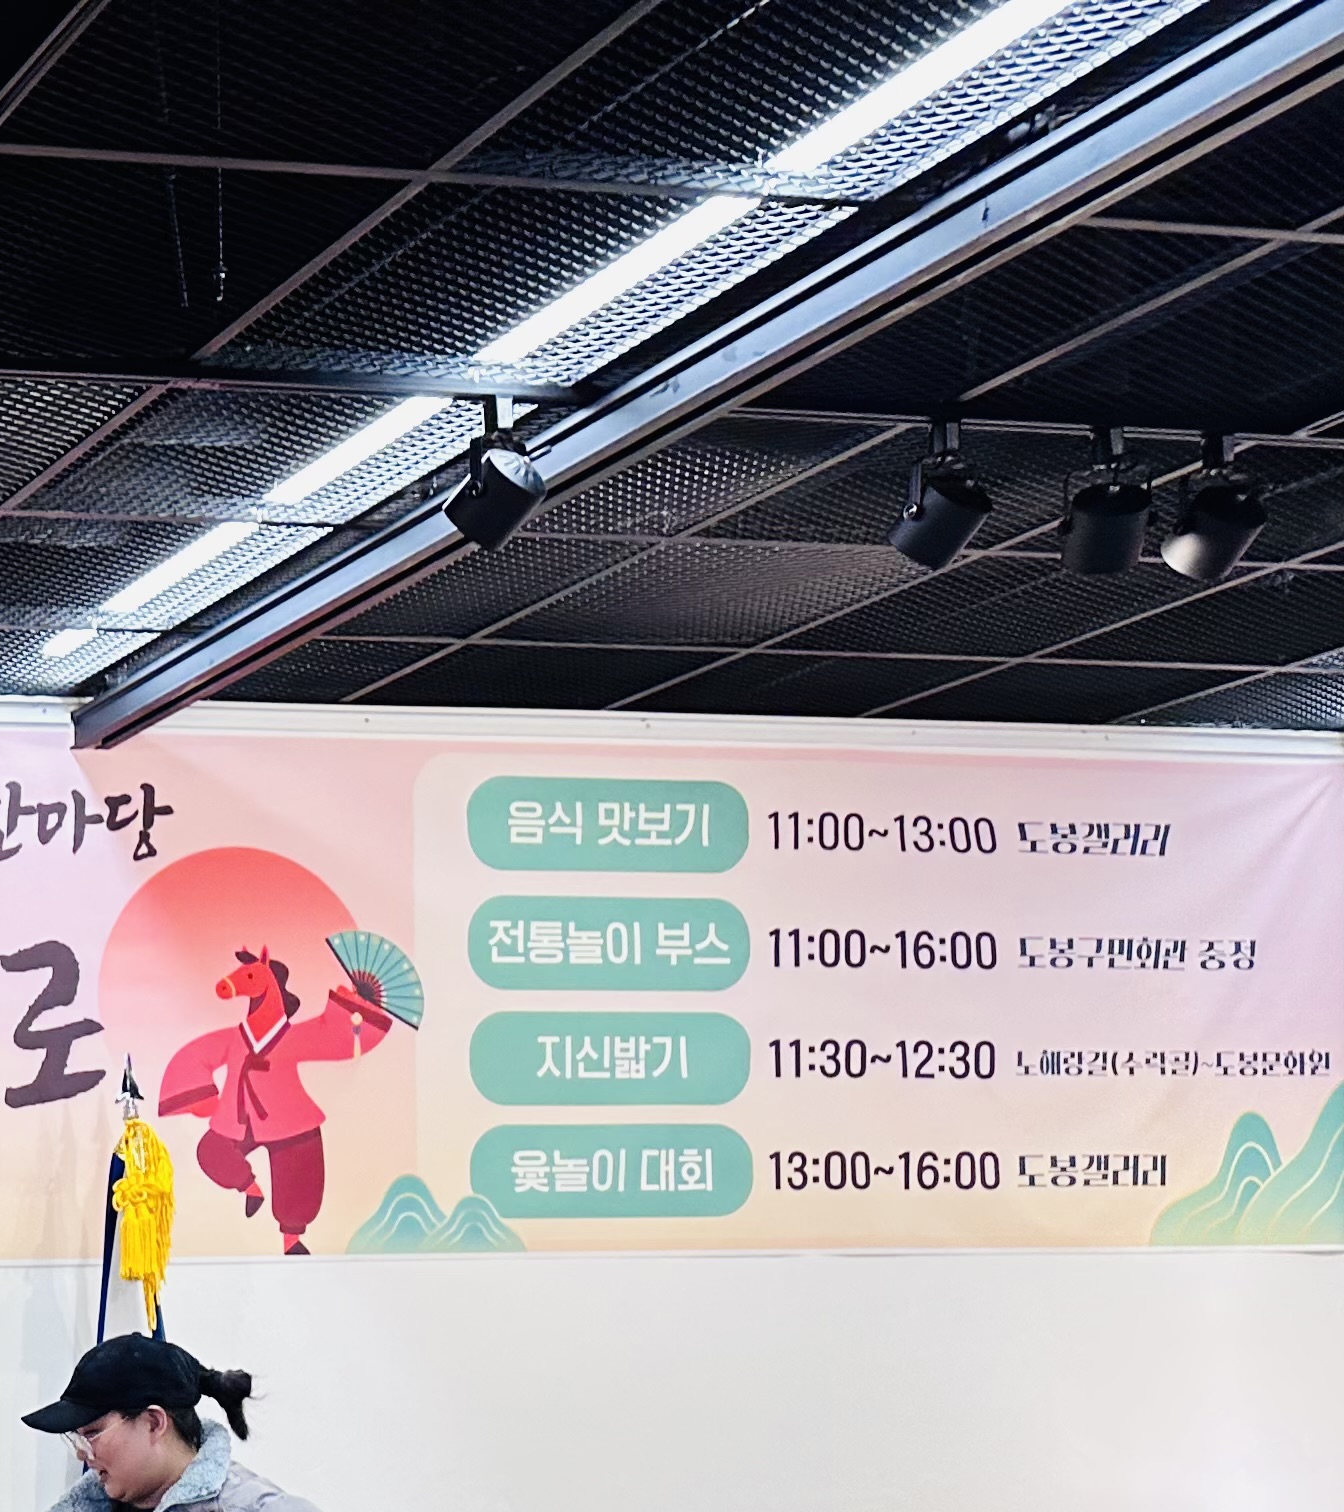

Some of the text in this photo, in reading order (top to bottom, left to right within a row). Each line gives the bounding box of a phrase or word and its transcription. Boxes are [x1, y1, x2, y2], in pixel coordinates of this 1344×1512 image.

[508, 802, 709, 846] 음식 맛보기
[768, 812, 996, 854] 11:00~13:00
[1018, 822, 1170, 856] 도봉갤러리
[489, 920, 730, 965] 전통놀이 부스
[769, 929, 996, 970] 11:00~16:00
[1020, 937, 1256, 969] 도봉구민회관 중정
[537, 1036, 687, 1079] 지신밟기
[769, 1039, 995, 1079] 11:30~12:30
[511, 1149, 712, 1192] 윷놀이 대회
[769, 1151, 1000, 1190] 13:00~16:00
[1019, 1155, 1166, 1186] 도봉갤러리
